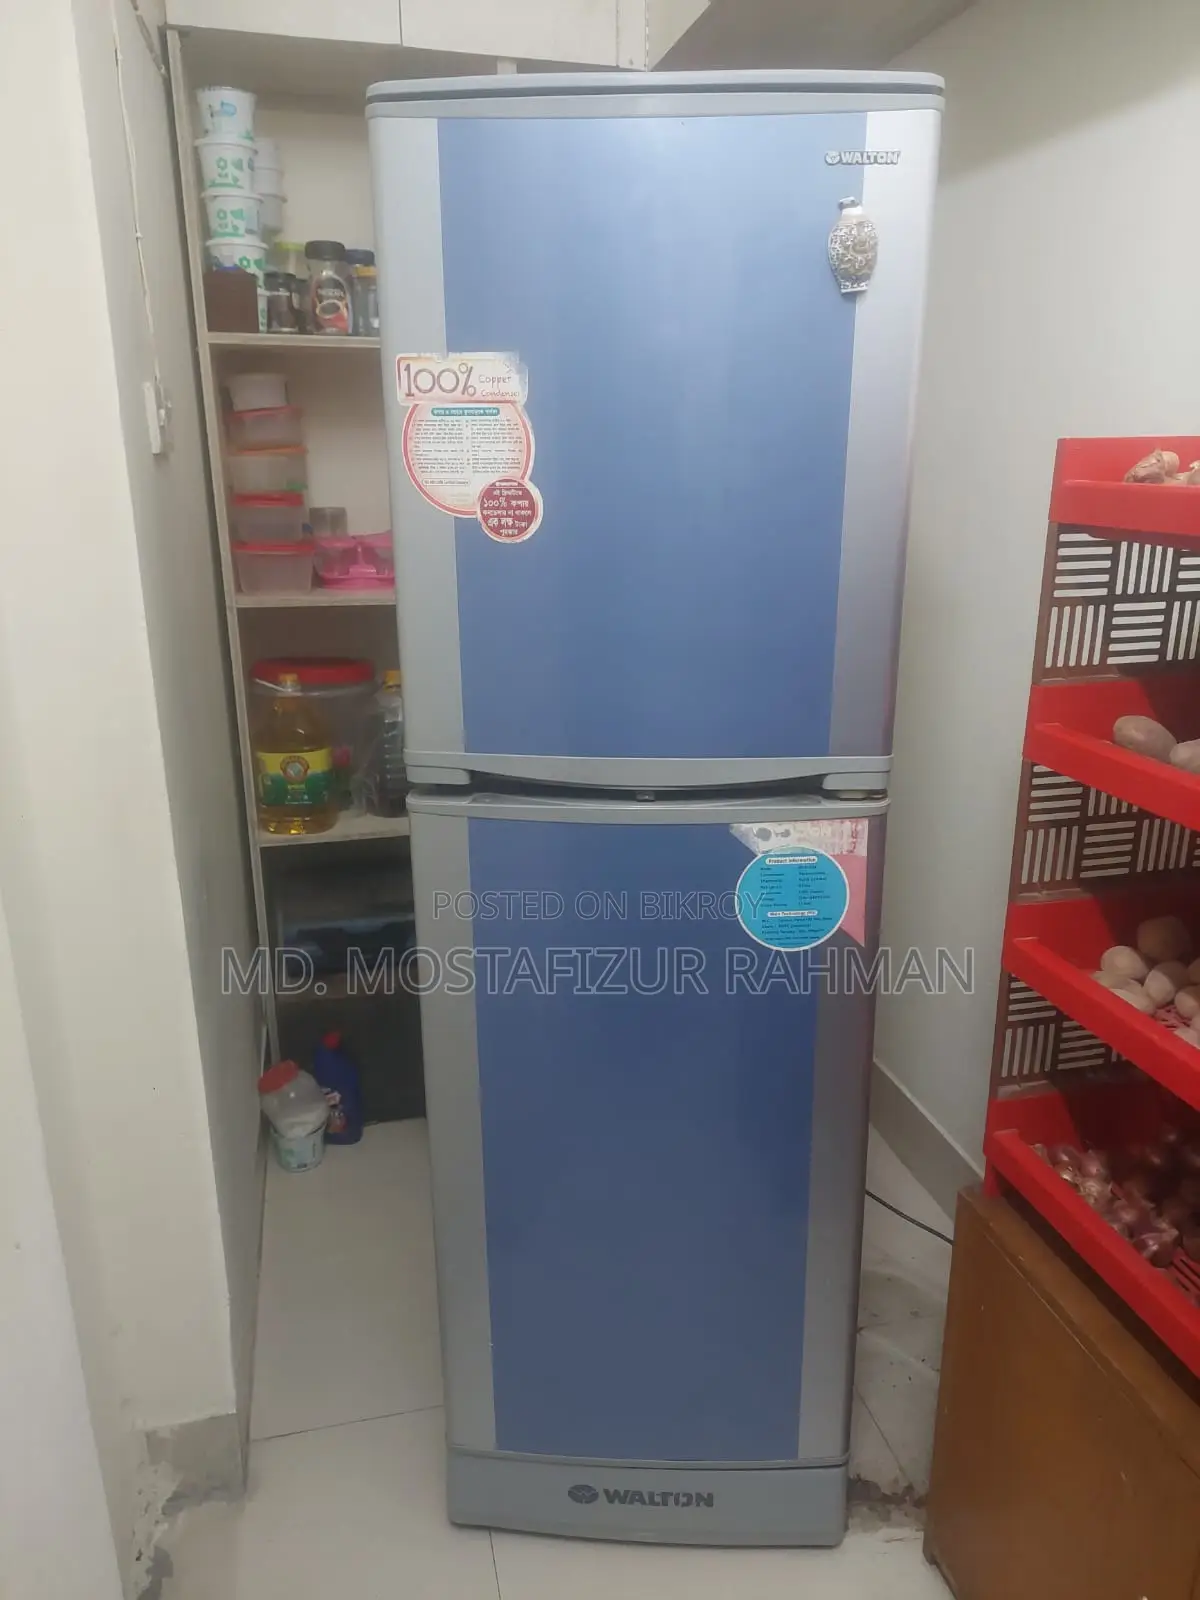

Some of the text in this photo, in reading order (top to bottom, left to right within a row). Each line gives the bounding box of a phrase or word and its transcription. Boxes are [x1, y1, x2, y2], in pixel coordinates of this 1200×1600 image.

[841, 151, 901, 165] WALTON
[403, 362, 477, 397] 100%
[478, 374, 512, 389] Copper
[483, 496, 507, 508] ১০০%
[603, 1488, 714, 1507] WALTON
